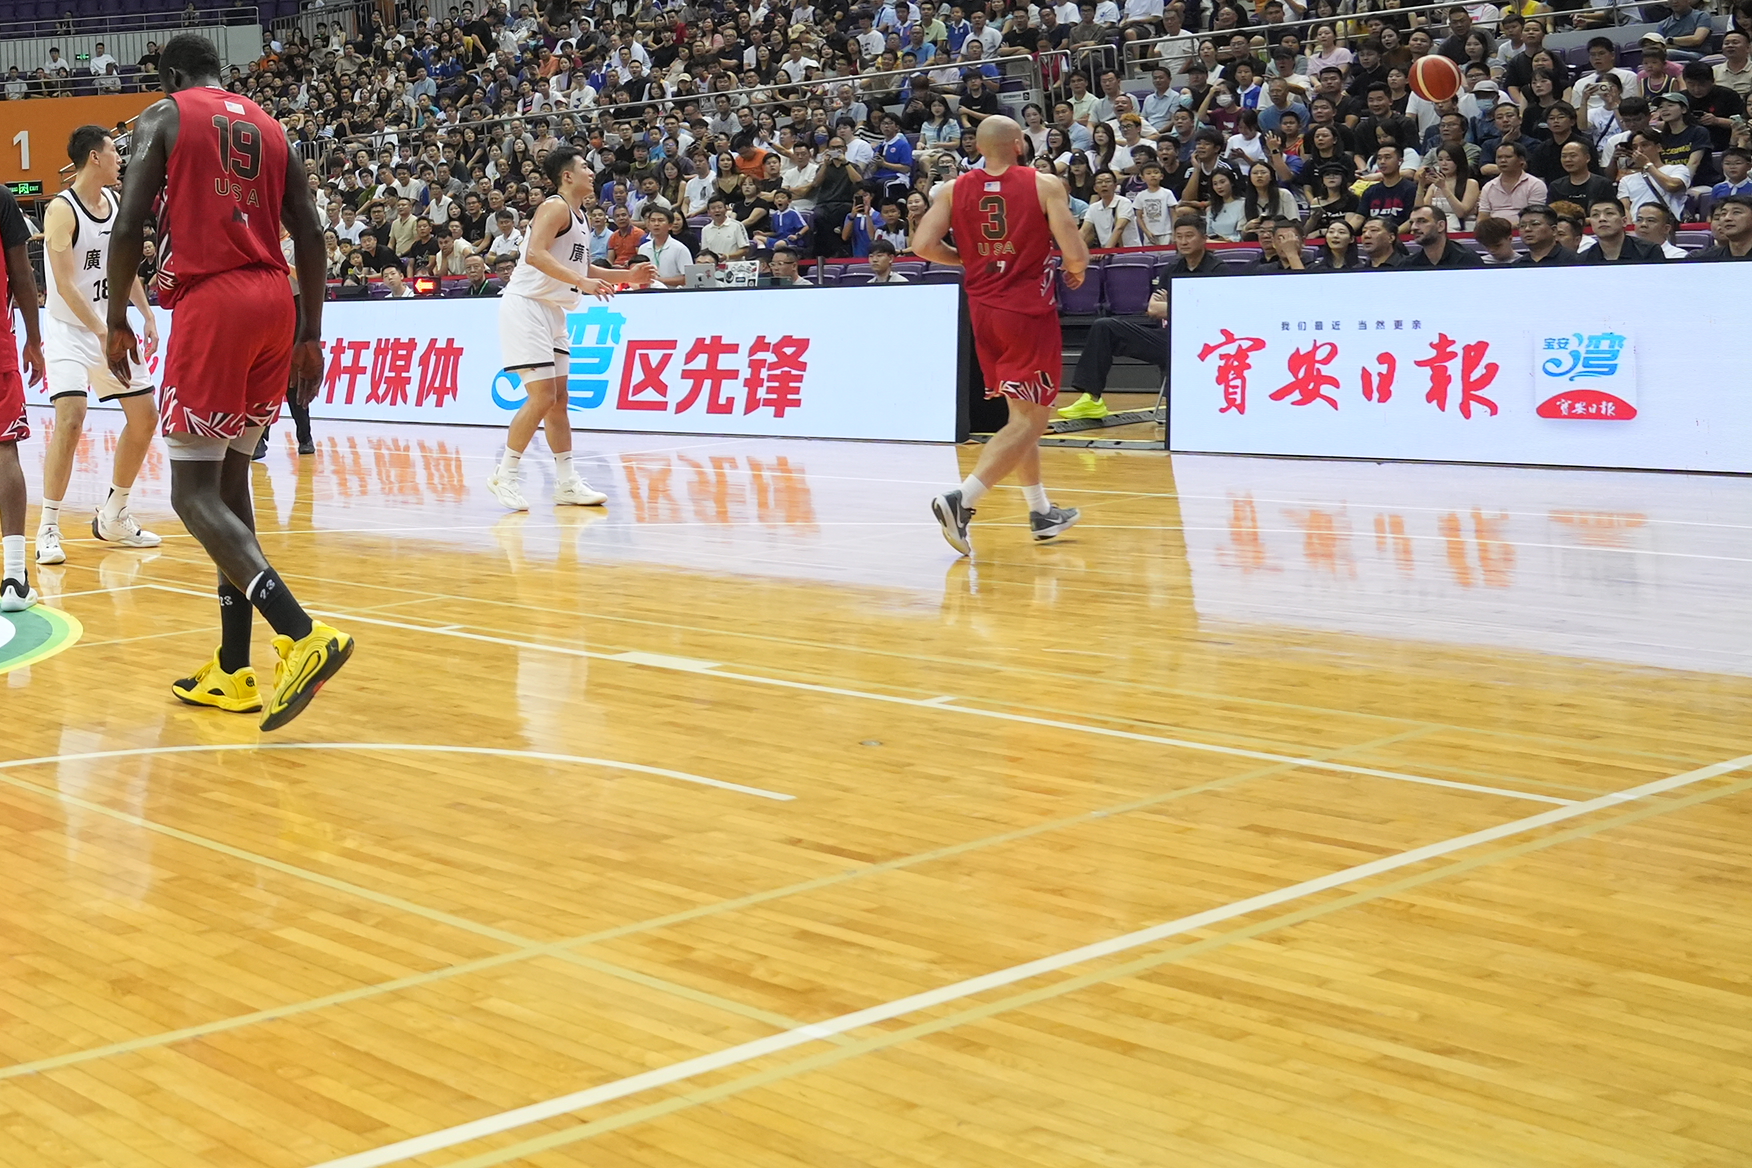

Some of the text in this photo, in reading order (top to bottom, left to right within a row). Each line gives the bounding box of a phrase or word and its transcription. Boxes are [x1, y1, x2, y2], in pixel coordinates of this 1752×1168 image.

[13, 130, 30, 170] 1
[211, 114, 262, 182] 19
[214, 178, 260, 208] USA
[979, 194, 1008, 240] 3
[977, 240, 1016, 256] USA
[1281, 319, 1422, 332] 我们最近 当然更亲
[1542, 338, 1570, 350] 宝安
